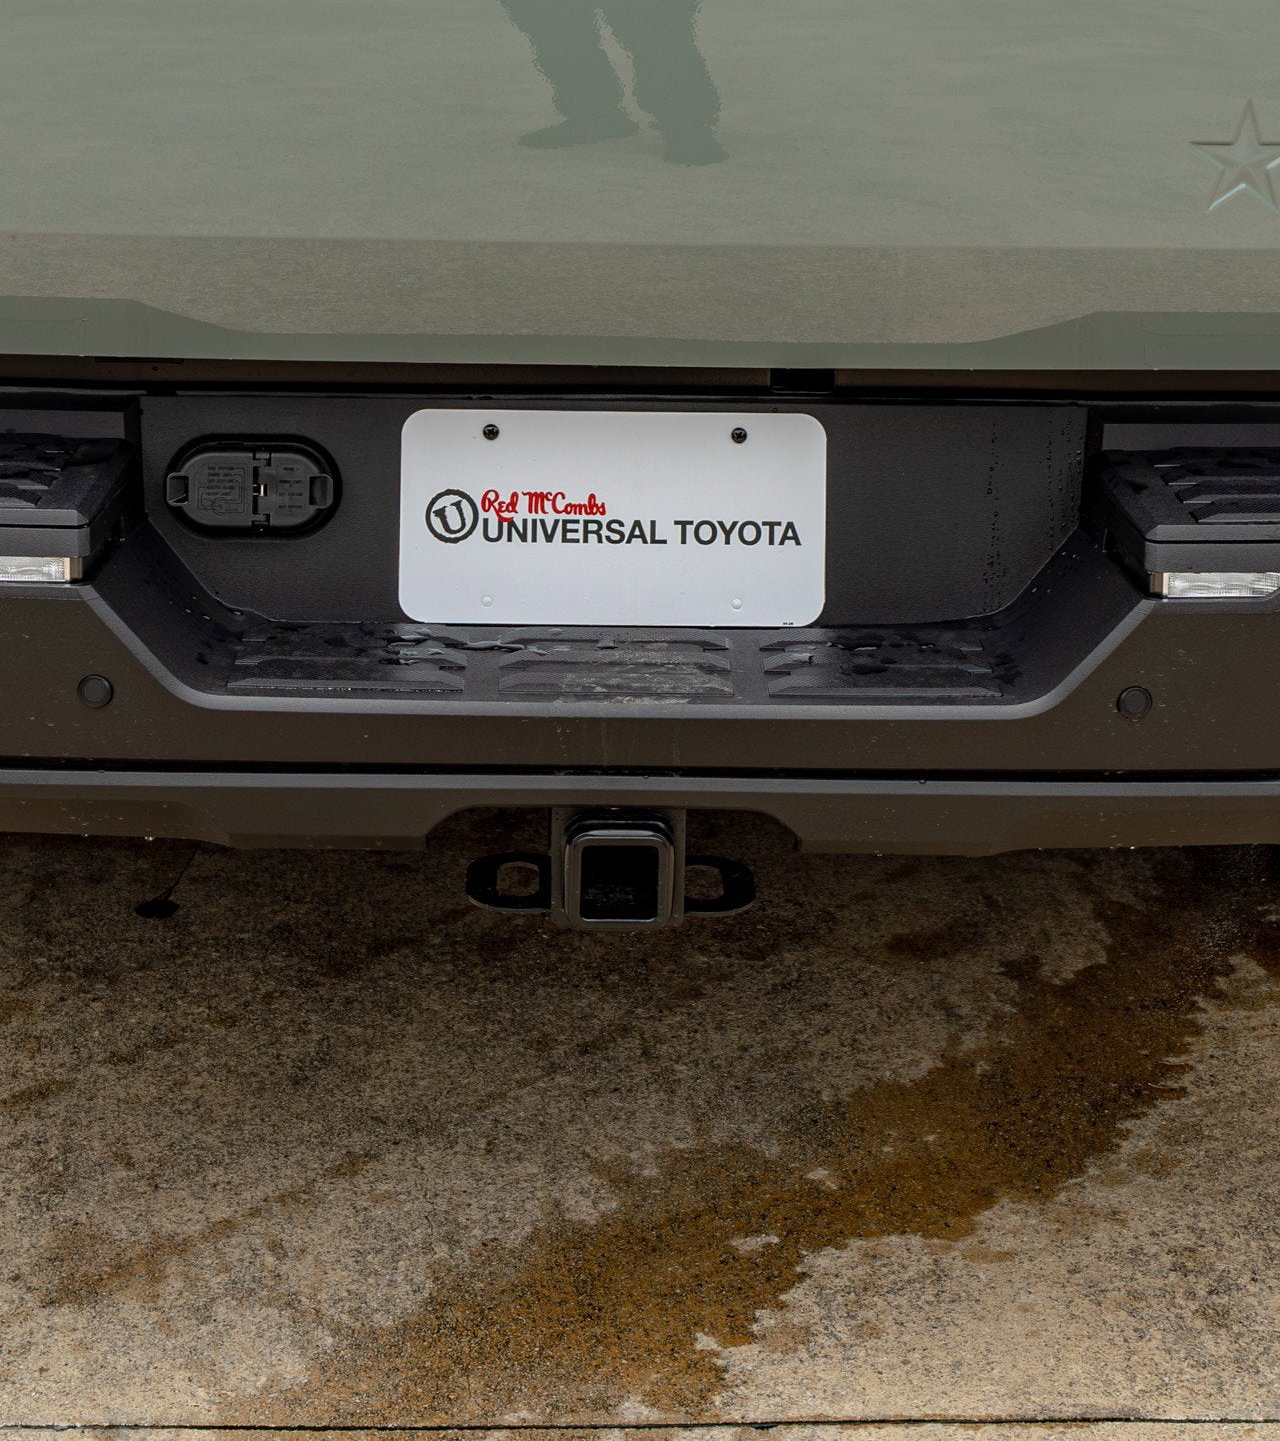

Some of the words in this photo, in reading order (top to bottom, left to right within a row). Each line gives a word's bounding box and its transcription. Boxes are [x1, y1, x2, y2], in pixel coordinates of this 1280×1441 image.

[481, 489, 519, 523] Red
[521, 490, 607, 517] McCombs
[482, 517, 667, 546] UNIVERSAL
[673, 519, 802, 547] TOYOTA
